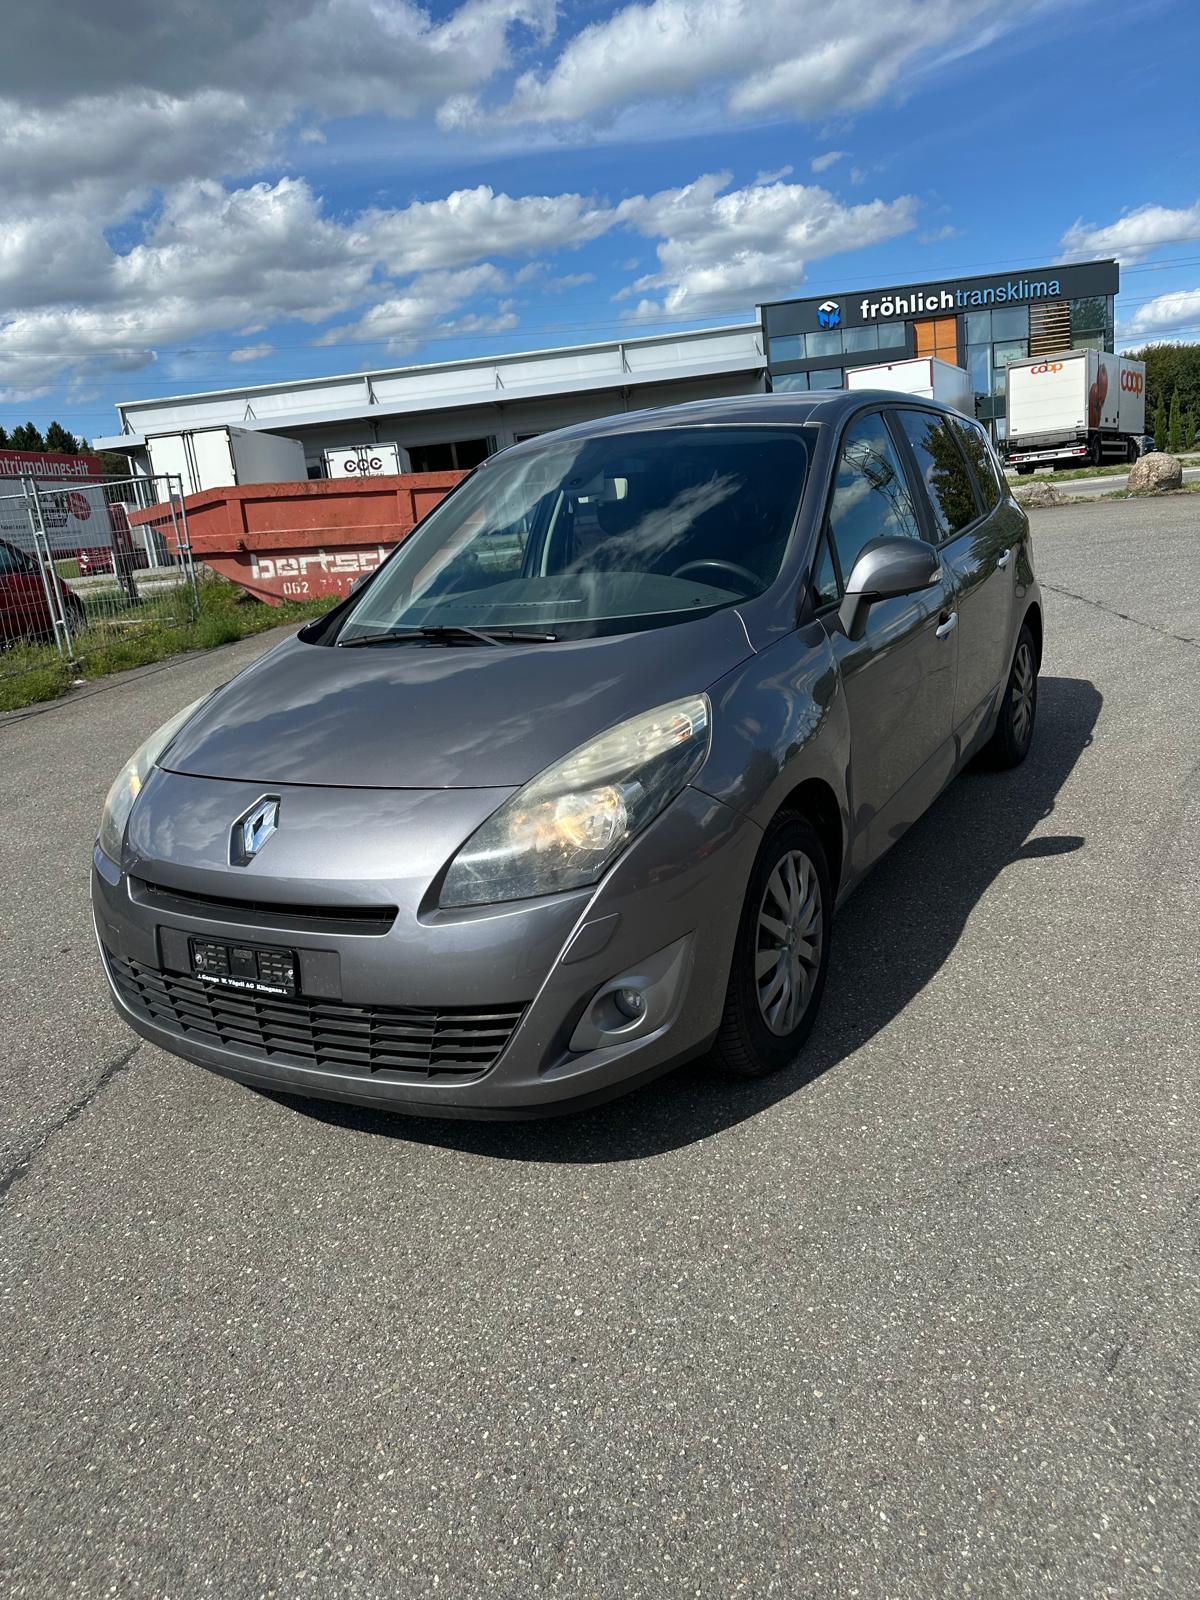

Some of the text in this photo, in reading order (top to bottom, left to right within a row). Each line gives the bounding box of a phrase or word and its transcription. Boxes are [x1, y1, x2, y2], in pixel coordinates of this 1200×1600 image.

[1031, 362, 1063, 374] coop
[1120, 369, 1143, 399] coop
[283, 581, 309, 594] 062
